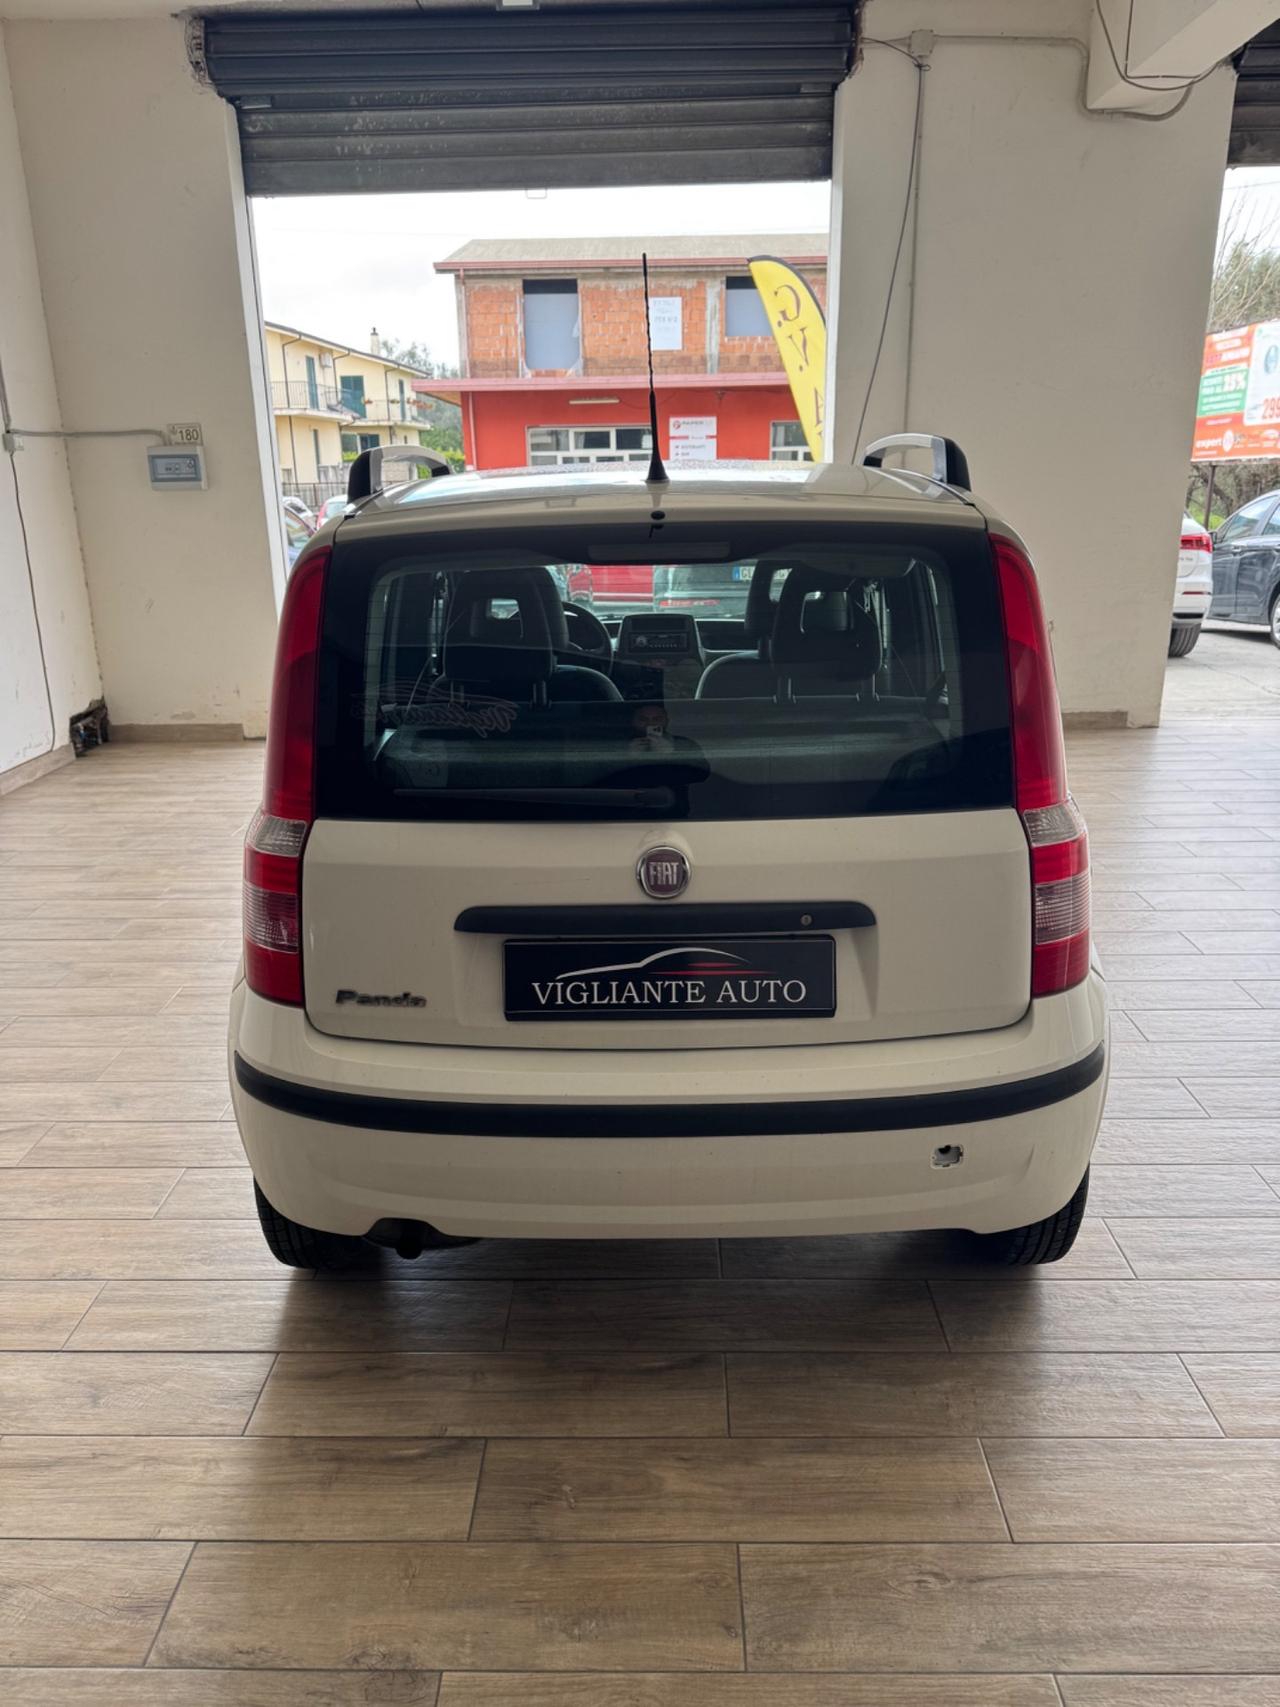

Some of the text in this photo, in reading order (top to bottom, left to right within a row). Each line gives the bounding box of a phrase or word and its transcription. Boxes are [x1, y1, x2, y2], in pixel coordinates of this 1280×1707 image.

[178, 429, 199, 441] 180
[649, 861, 679, 885] FIAT
[335, 989, 427, 1008] Panda
[532, 979, 806, 1004] VIGLIANTE AUTO
